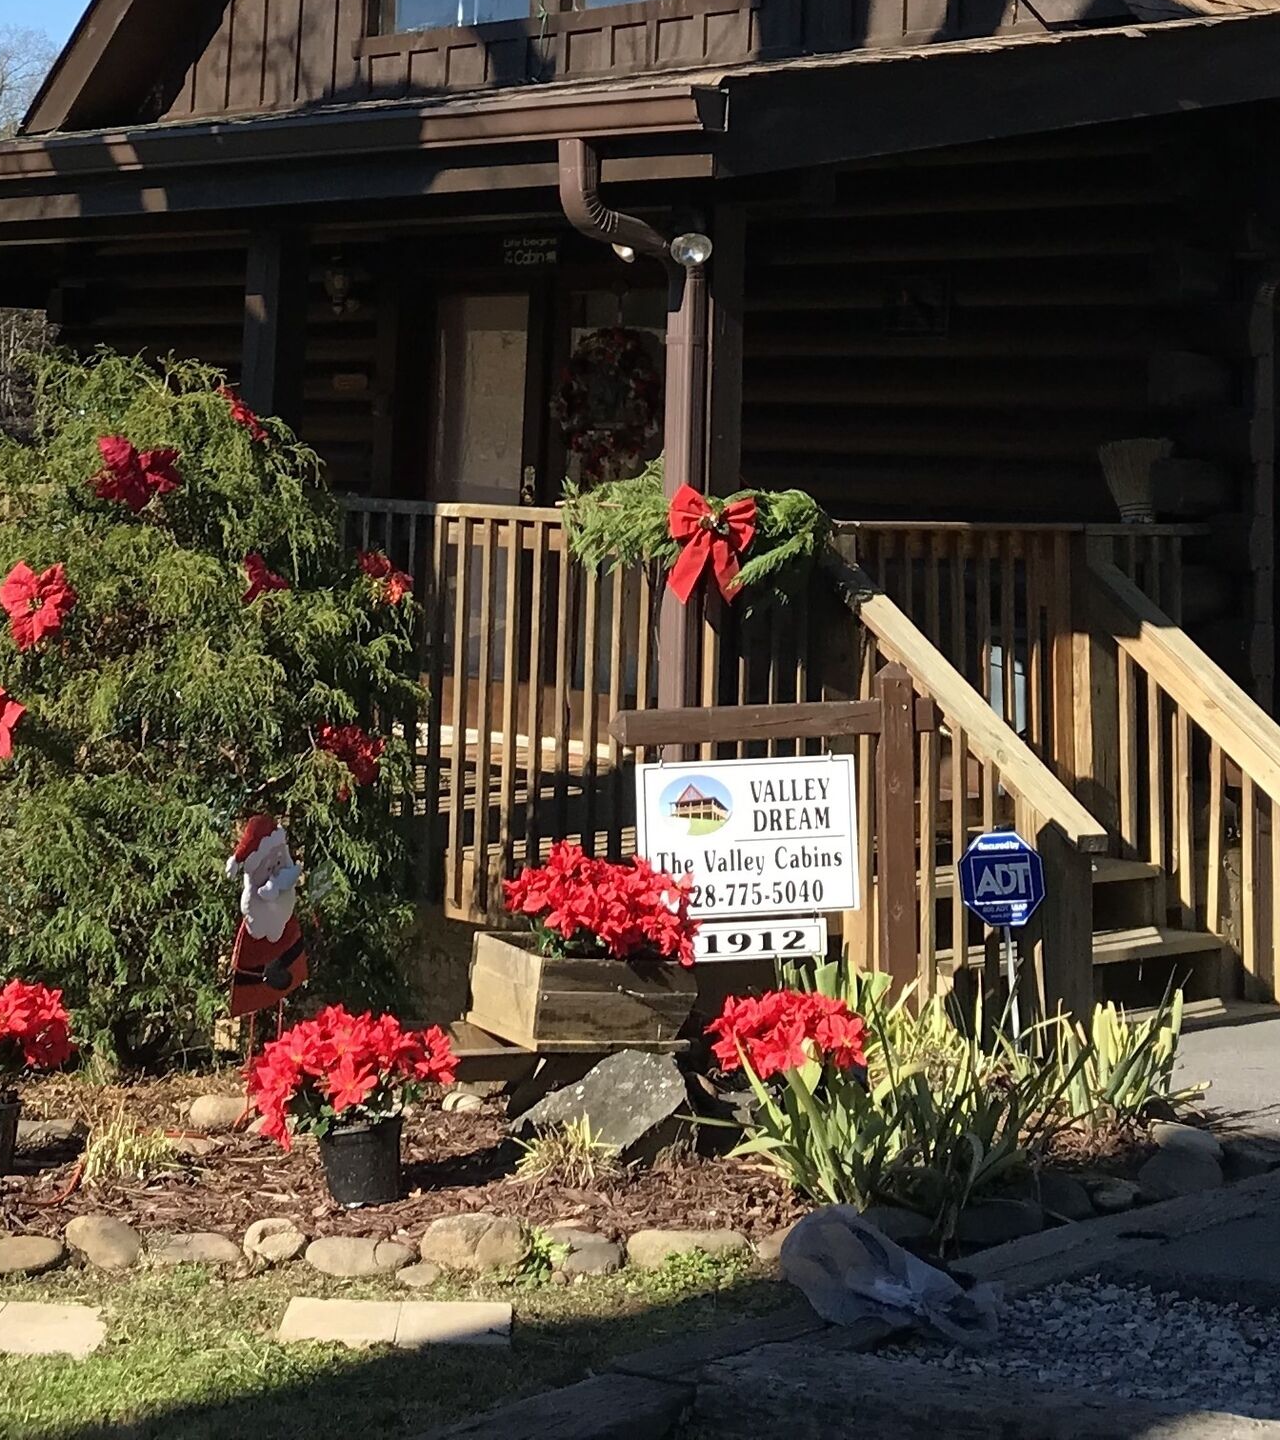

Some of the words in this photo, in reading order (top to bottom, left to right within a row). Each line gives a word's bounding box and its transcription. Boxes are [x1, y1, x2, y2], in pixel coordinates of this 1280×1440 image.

[750, 777, 830, 803] VALLEY
[753, 806, 831, 832] DREAM
[978, 842, 1009, 851] Secured
[656, 851, 694, 875] The
[704, 848, 765, 876] Valley
[774, 845, 843, 870] Cabins
[976, 862, 1029, 897] ADT
[689, 879, 824, 908] 28-775-5040
[703, 929, 806, 954] 1912
